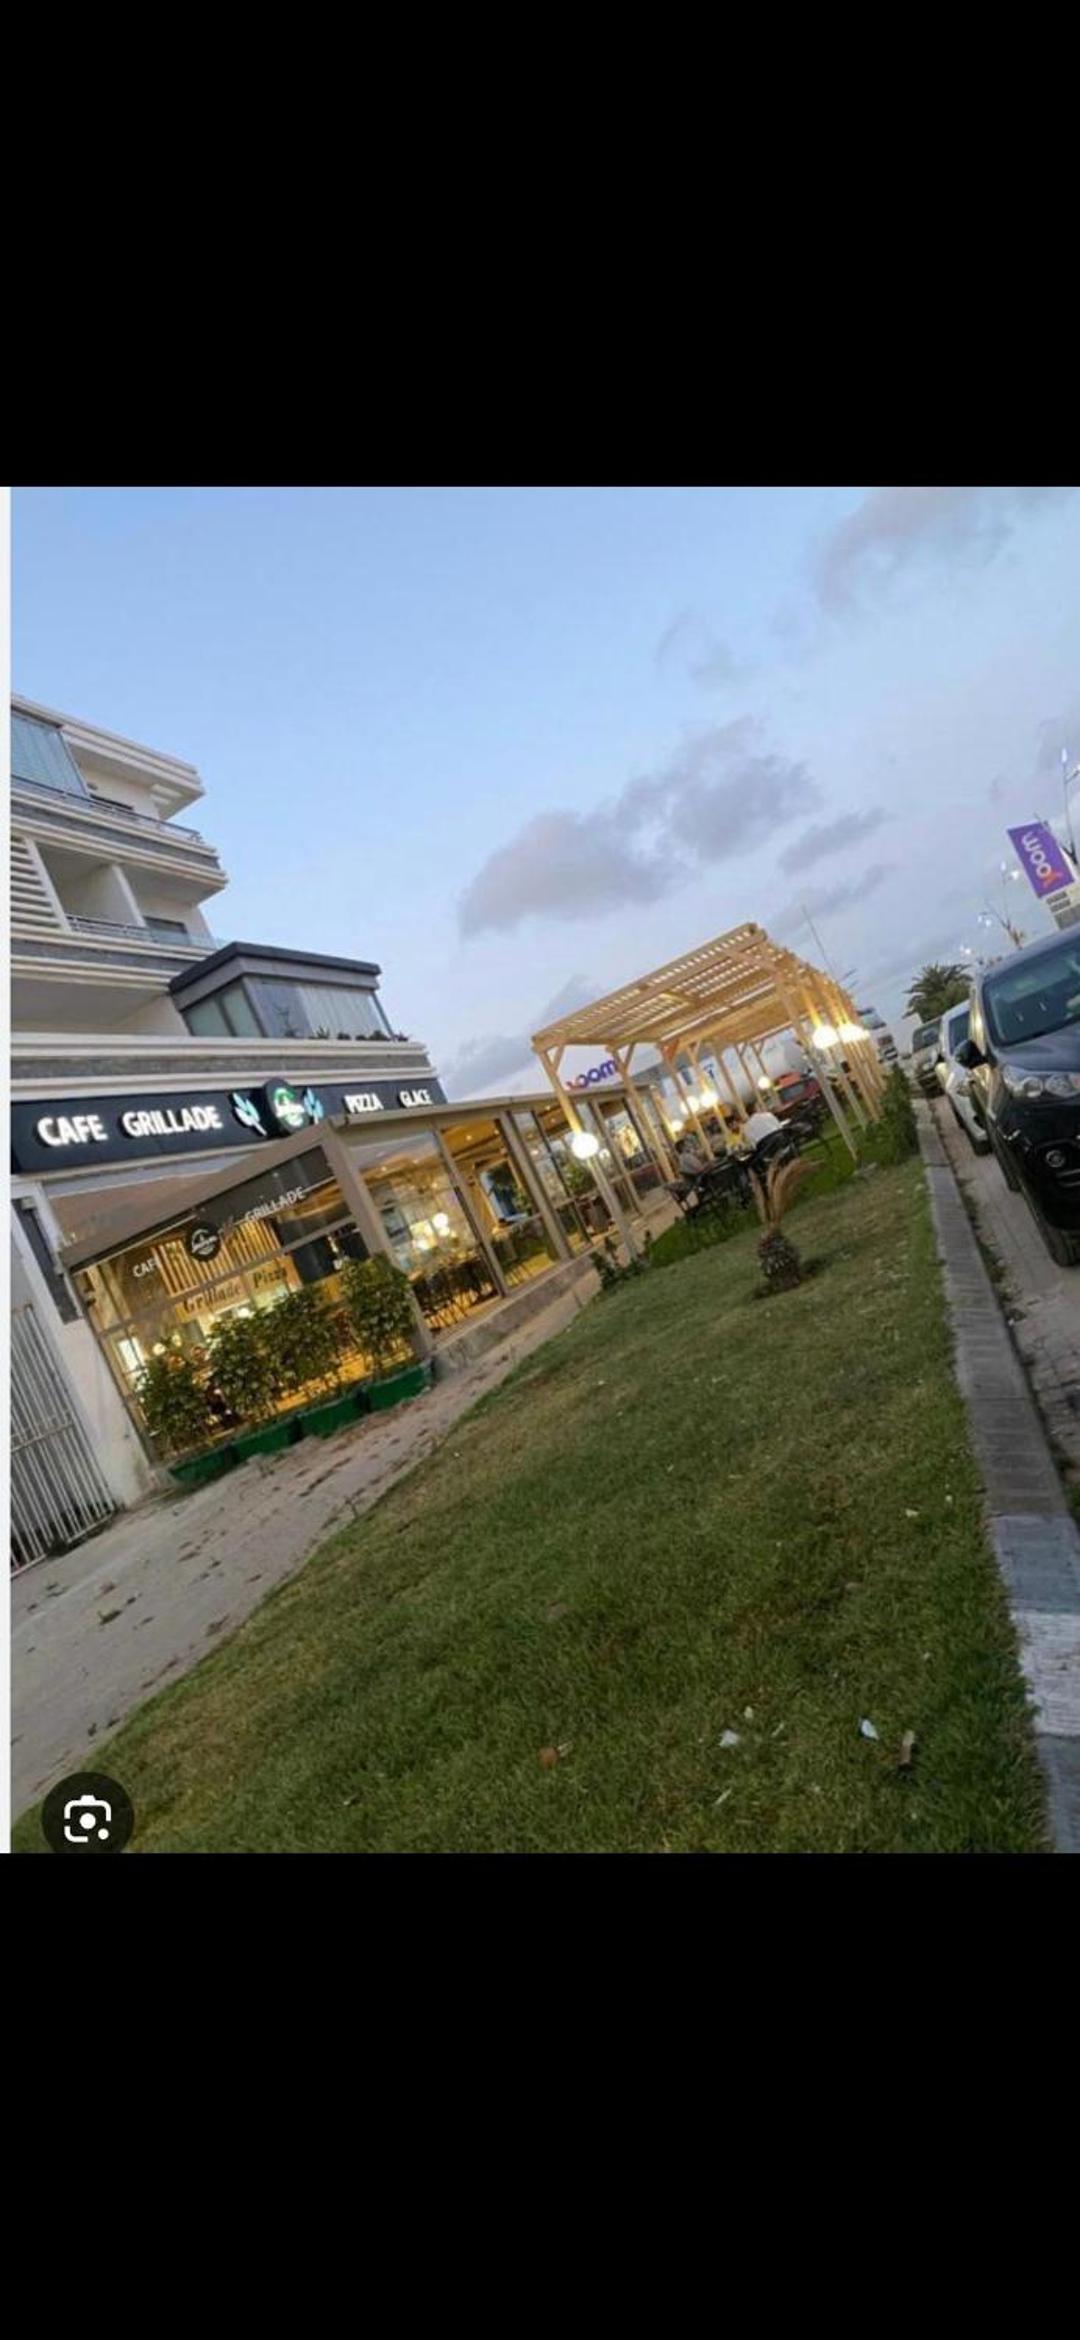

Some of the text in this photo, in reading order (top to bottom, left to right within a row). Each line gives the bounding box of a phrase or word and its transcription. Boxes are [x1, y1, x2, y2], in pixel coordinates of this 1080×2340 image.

[344, 1088, 434, 1114] PIZZA GLACE
[37, 1105, 224, 1147] CAFE GRILLADE
[244, 1185, 306, 1222] GRILLADE
